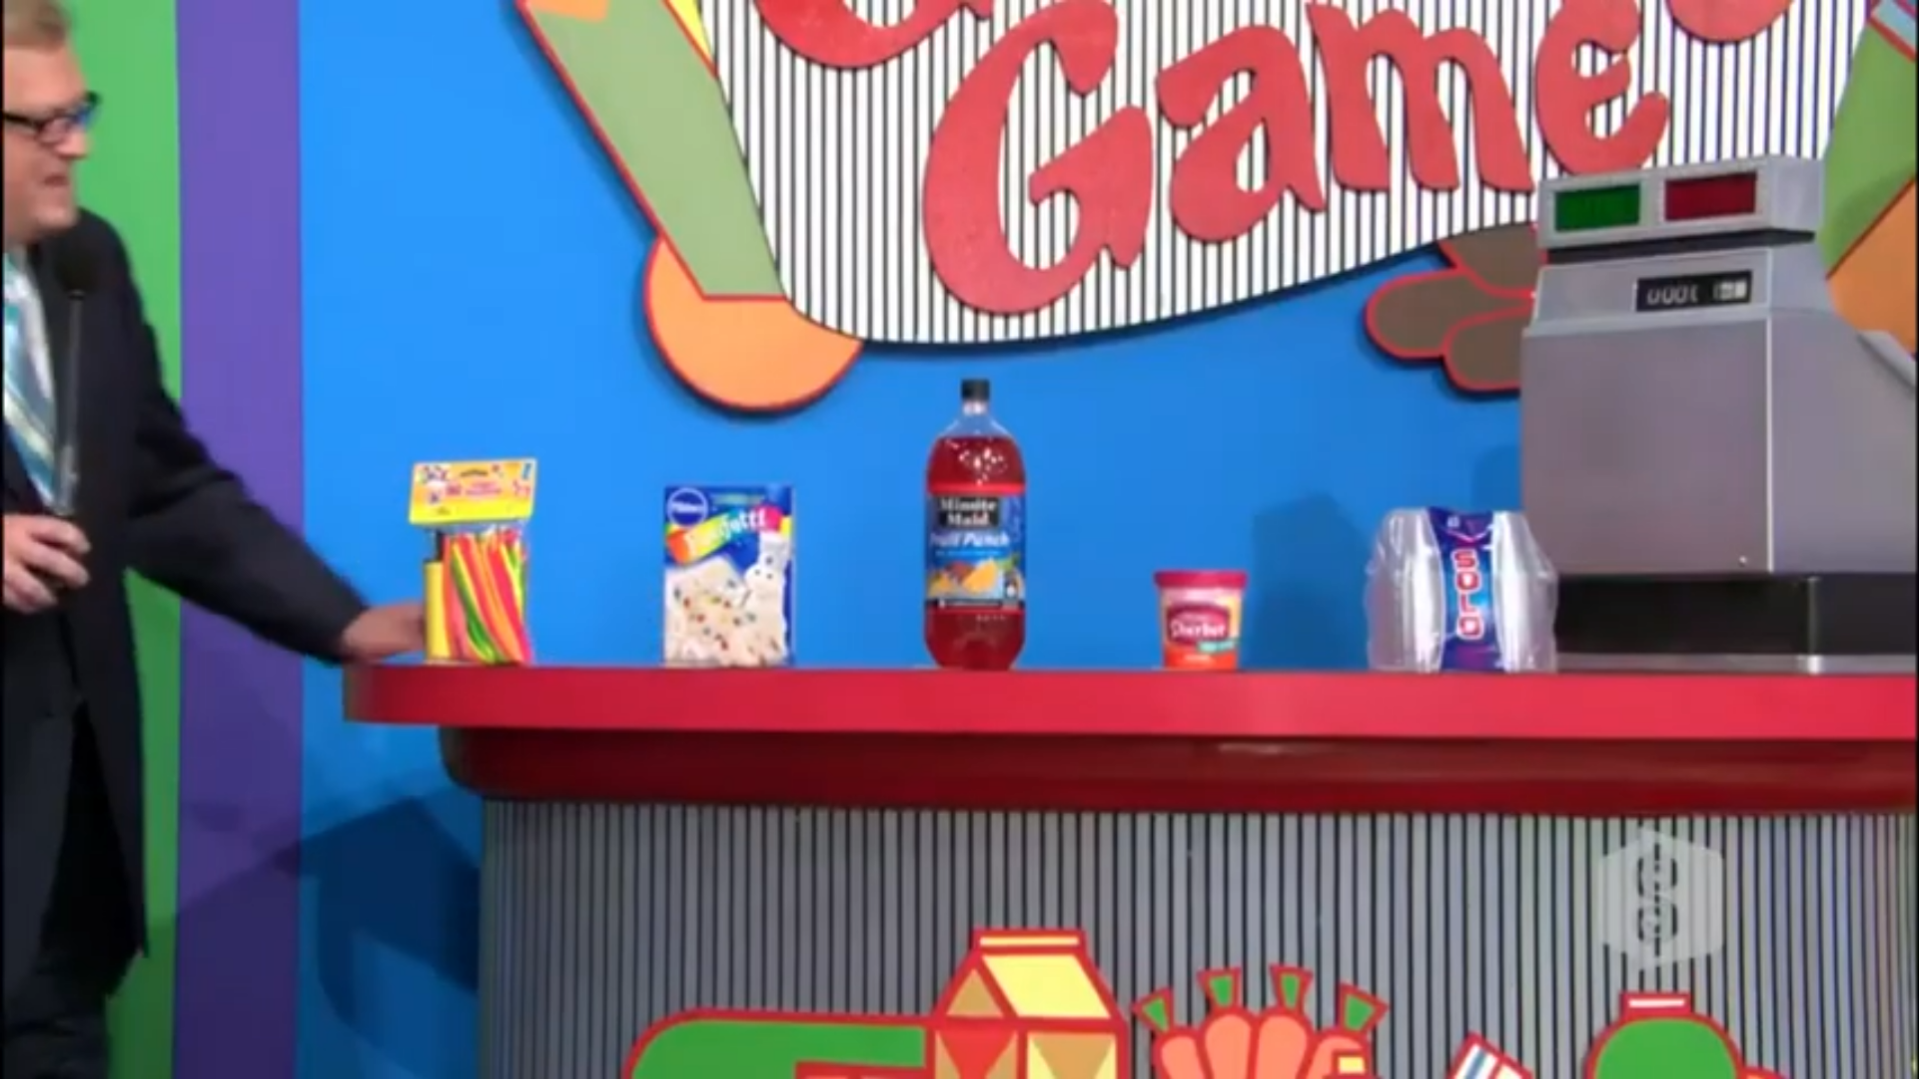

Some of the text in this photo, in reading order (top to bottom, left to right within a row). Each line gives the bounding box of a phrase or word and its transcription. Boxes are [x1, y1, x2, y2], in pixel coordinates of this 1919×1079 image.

[922, 0, 1669, 316] Game
[940, 497, 998, 511] Minute
[947, 511, 989, 526] Maid
[962, 530, 1010, 547] Punch
[1451, 548, 1486, 640] SOLO
